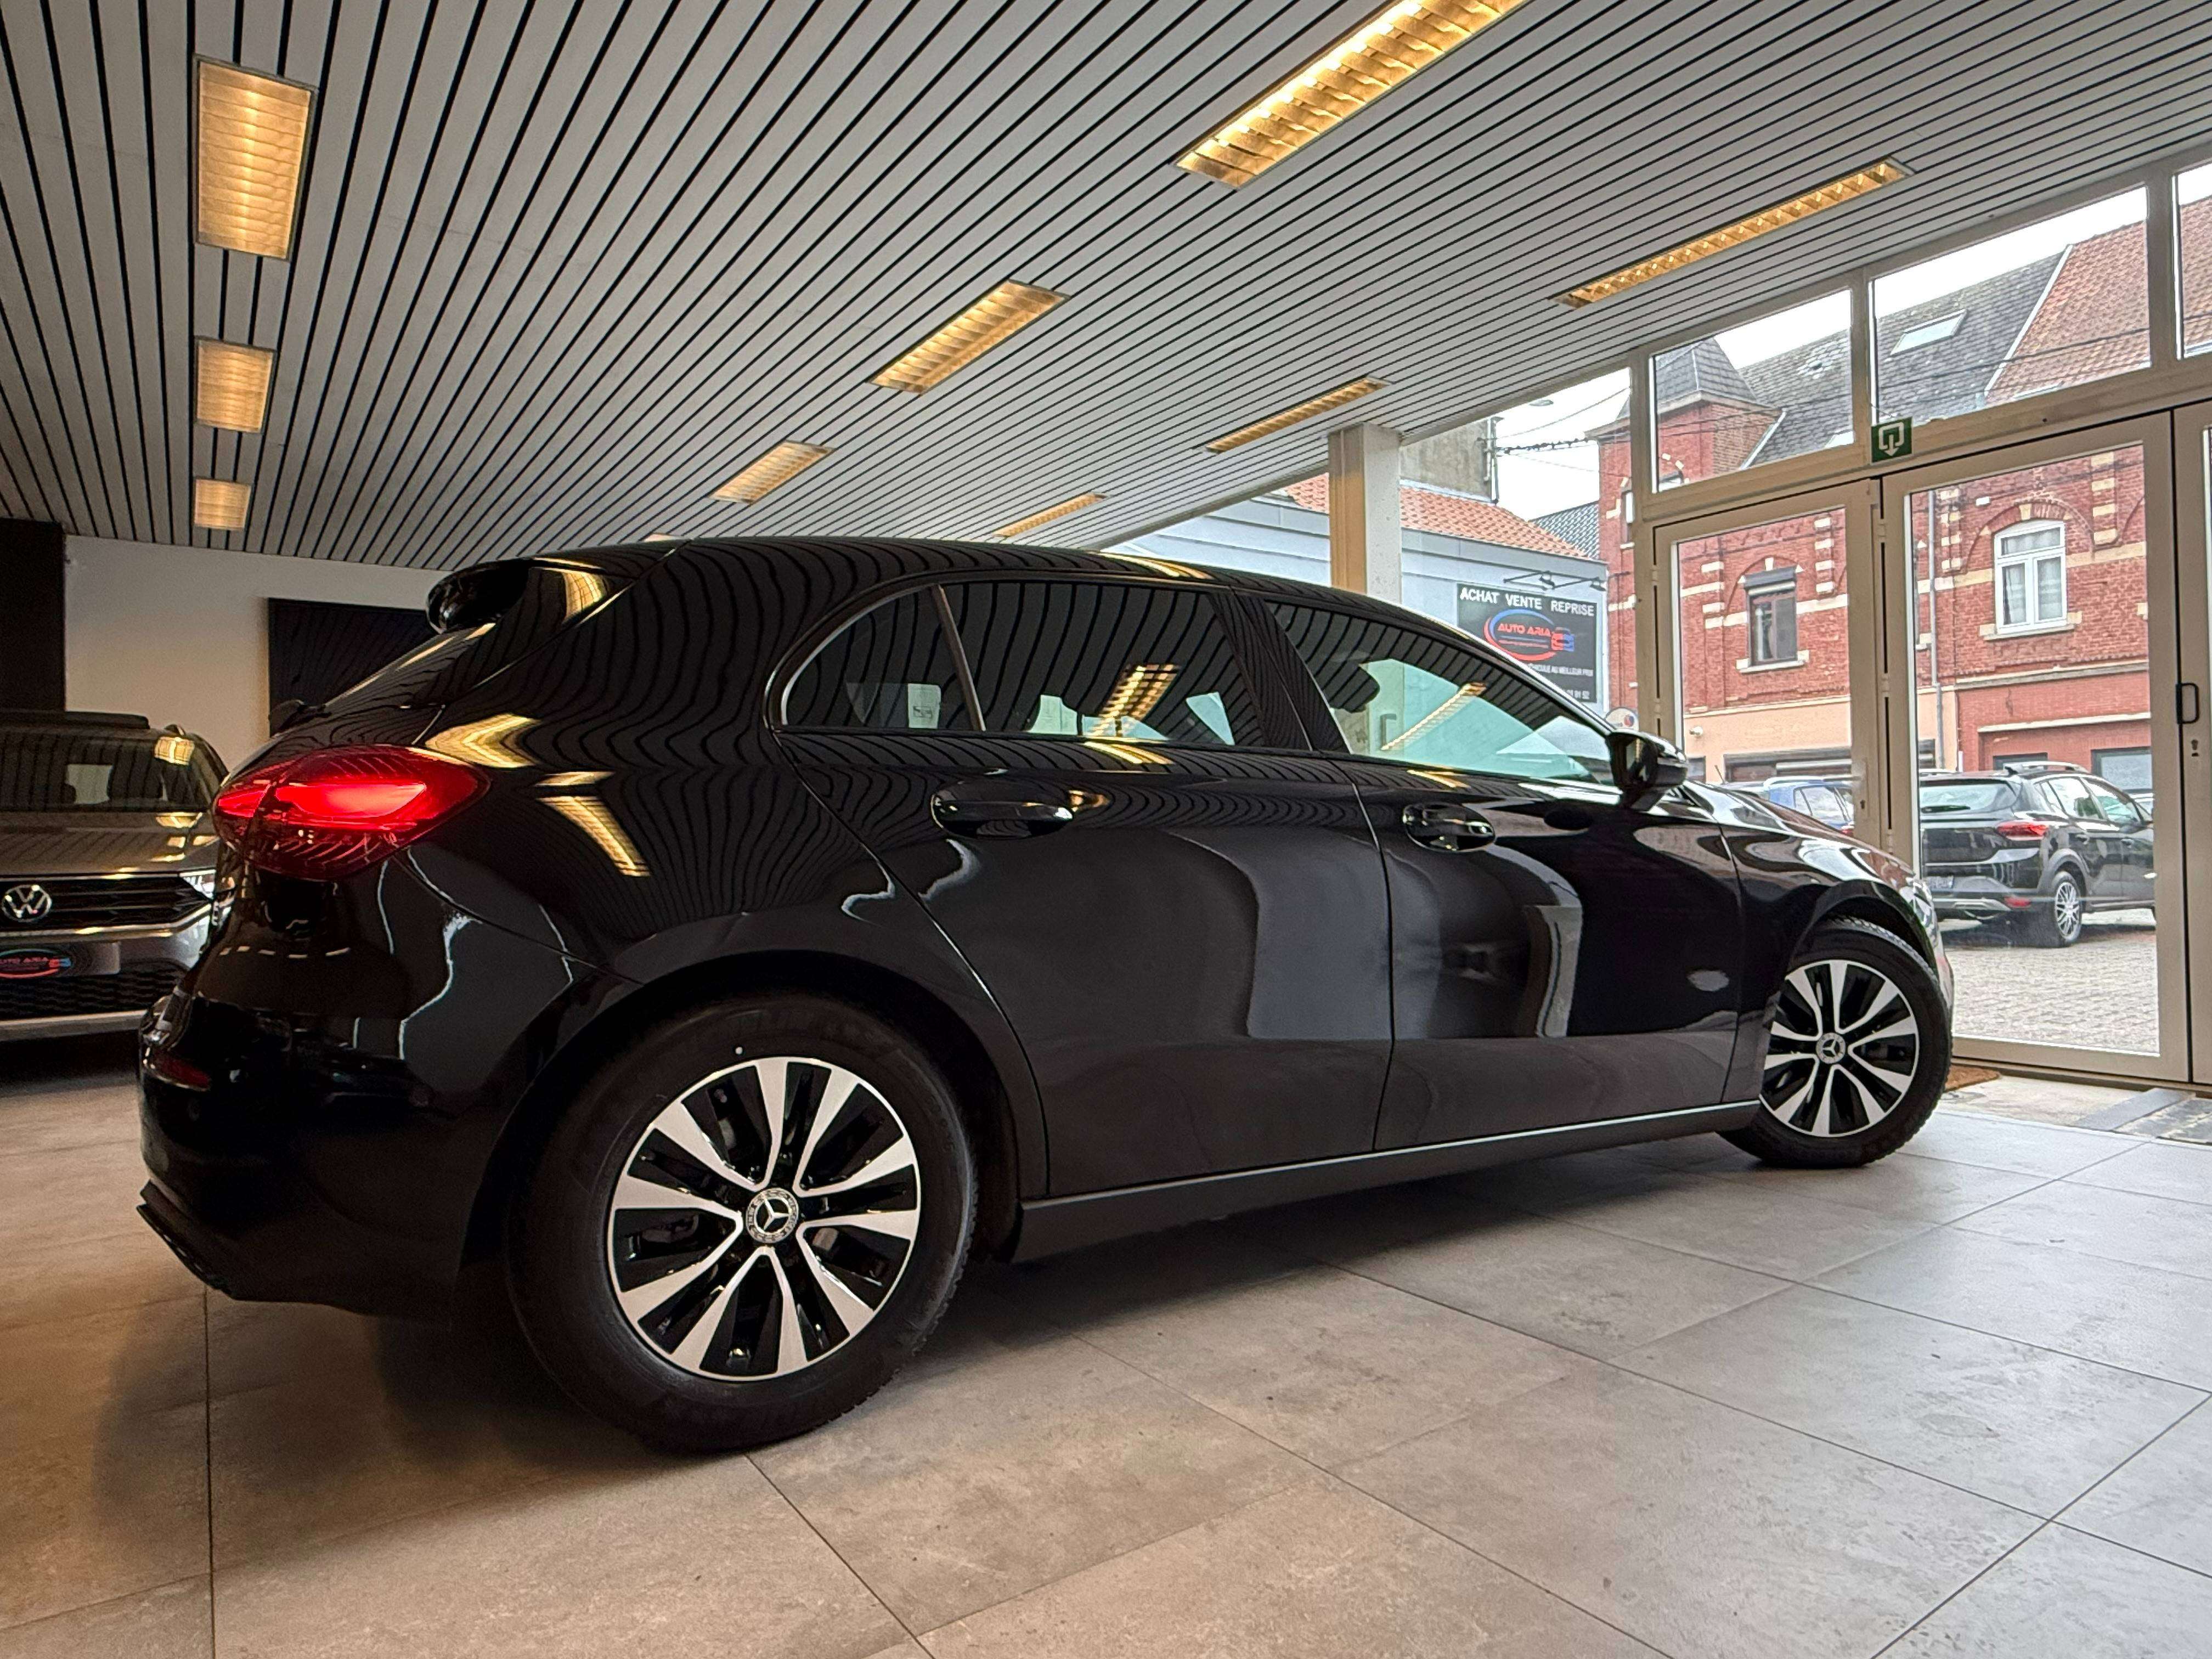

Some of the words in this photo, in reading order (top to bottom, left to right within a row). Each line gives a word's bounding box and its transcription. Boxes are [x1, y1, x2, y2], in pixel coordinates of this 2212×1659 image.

[1460, 587, 1499, 603] ACHAT
[1505, 594, 1542, 610] VENTE
[1550, 600, 1594, 617] REPRISE
[1497, 623, 1525, 634] AUTO
[1527, 626, 1551, 637] ARIA
